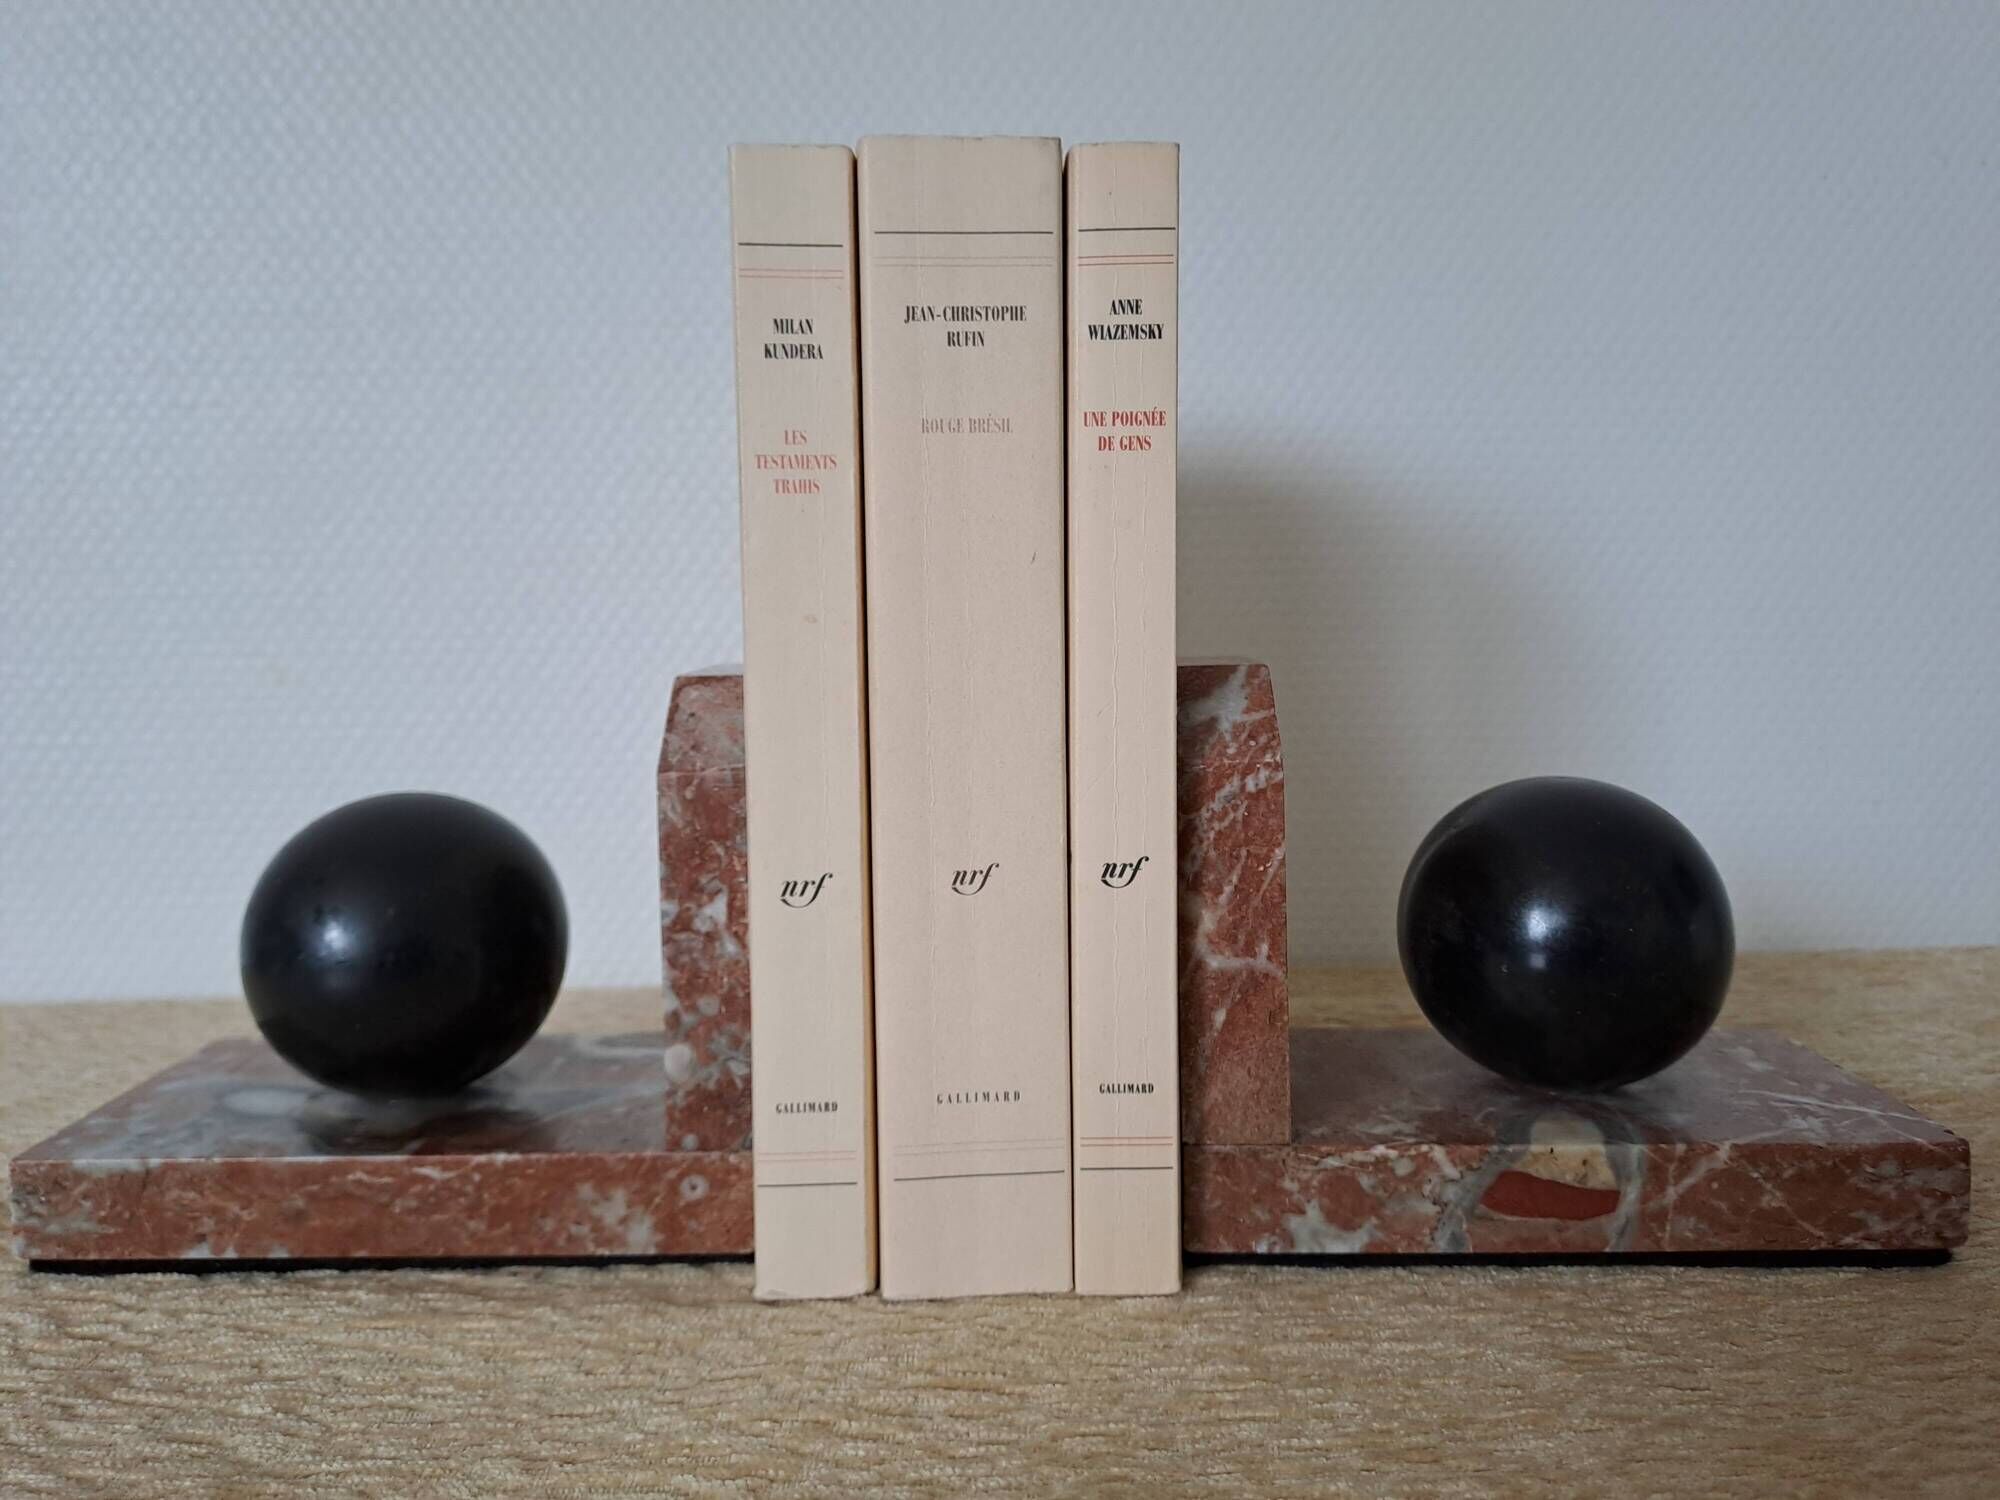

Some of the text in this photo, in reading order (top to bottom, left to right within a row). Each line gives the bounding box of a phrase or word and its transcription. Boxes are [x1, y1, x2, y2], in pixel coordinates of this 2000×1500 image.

[904, 304, 1027, 324] JEAN-CHRISTOPHE
[1109, 298, 1143, 316] ANNE
[773, 317, 813, 336] MILAN
[1088, 323, 1165, 341] WIAZEMSKY
[947, 330, 985, 348] RUFIN
[764, 342, 824, 360] KUNDERA
[921, 412, 1013, 435] ROUGE BRÉSIL
[1083, 406, 1167, 427] UNE POIGNÉE
[784, 429, 808, 446] LES
[1098, 434, 1152, 452] DE GENS
[754, 454, 838, 471] TESTAMENTS
[774, 478, 821, 495] TRAHIS
[951, 862, 1000, 896] nrf
[1100, 855, 1150, 889] nrf
[780, 872, 833, 908] nrf
[936, 1090, 1021, 1105] GALLIMARD
[1099, 1083, 1154, 1095] GALLIMARD
[776, 1101, 838, 1114] GALLIMARD
